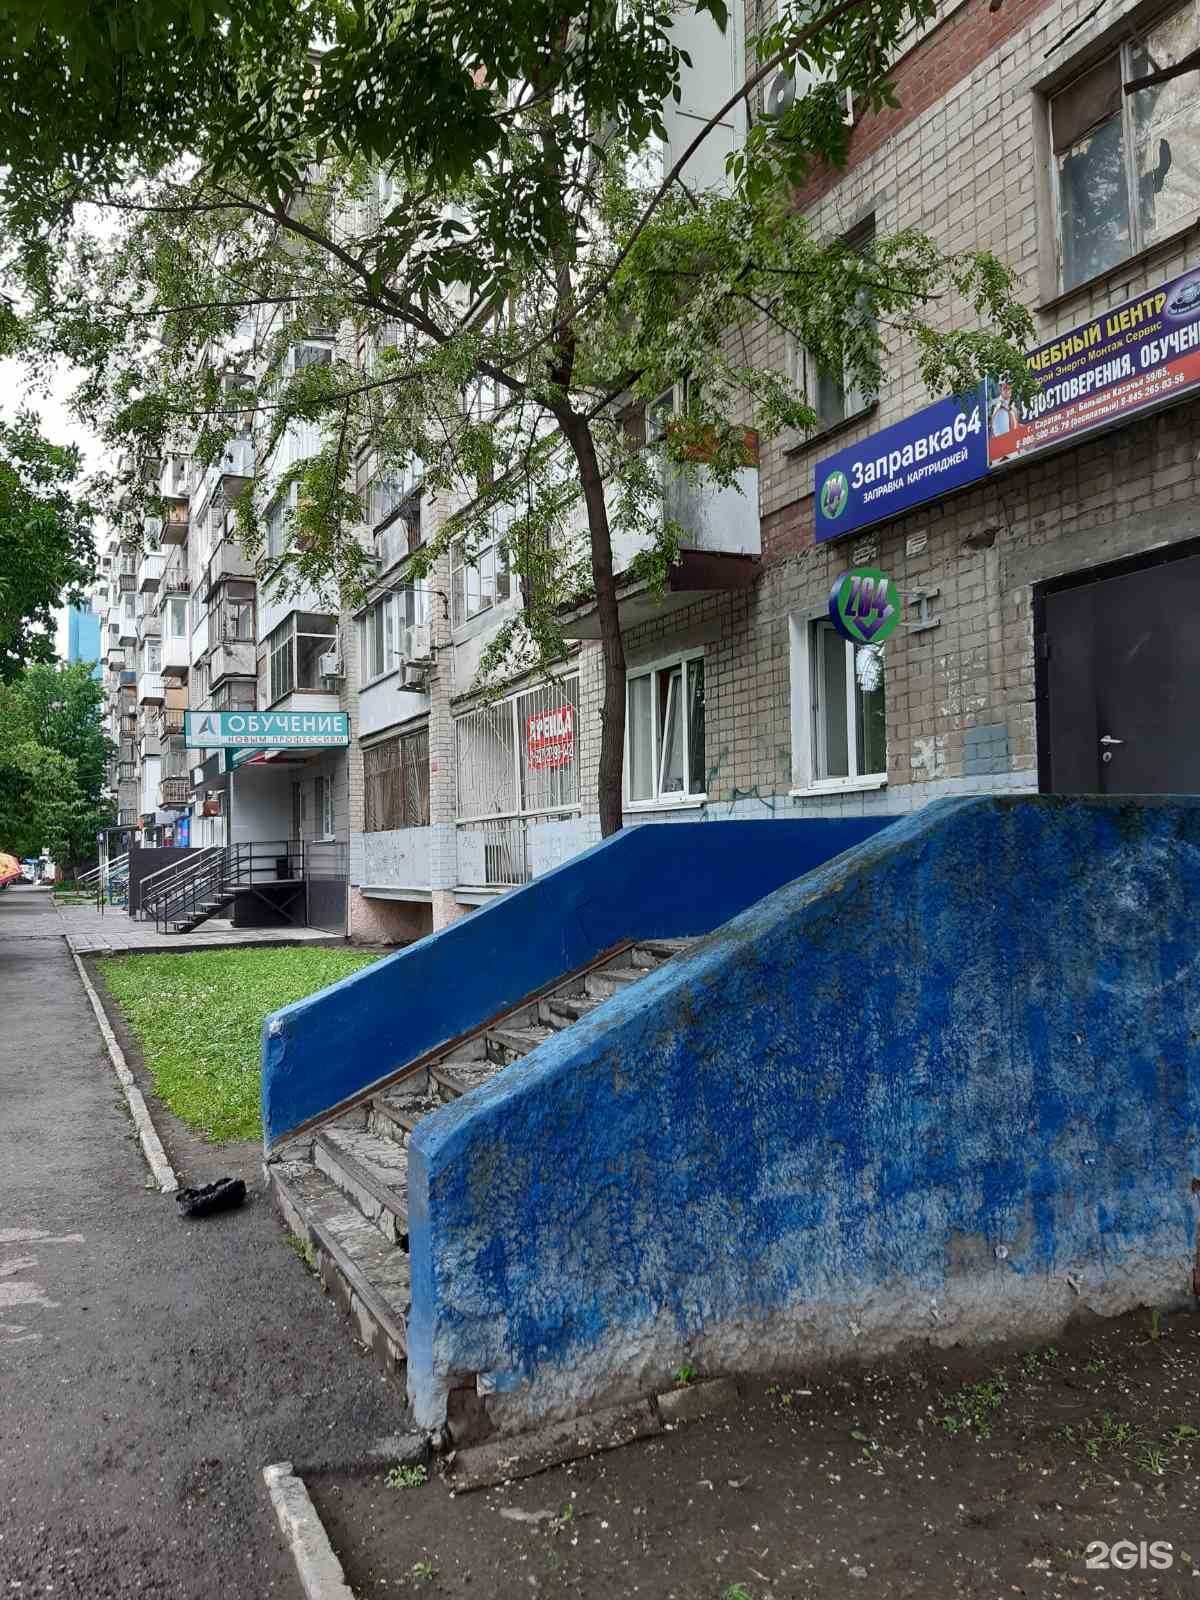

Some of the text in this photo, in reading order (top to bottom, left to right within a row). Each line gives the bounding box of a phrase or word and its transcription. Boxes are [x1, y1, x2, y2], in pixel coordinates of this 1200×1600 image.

[1106, 291, 1168, 338] ЦЕНТР
[1055, 356, 1087, 377] Энерго
[1088, 339, 1124, 363] Монтаж
[1125, 321, 1163, 344] Сервис
[1140, 320, 1200, 368] ОБУЧЕН
[1066, 407, 1078, 418] ул.
[1078, 391, 1111, 412] Большая
[1112, 378, 1144, 396] Казачья
[851, 404, 982, 489] Заправка64
[863, 446, 969, 504] ЗАПРАВКА КАРТРИДЖЕЙ
[227, 714, 344, 733] ОБУЧЕНИЕ
